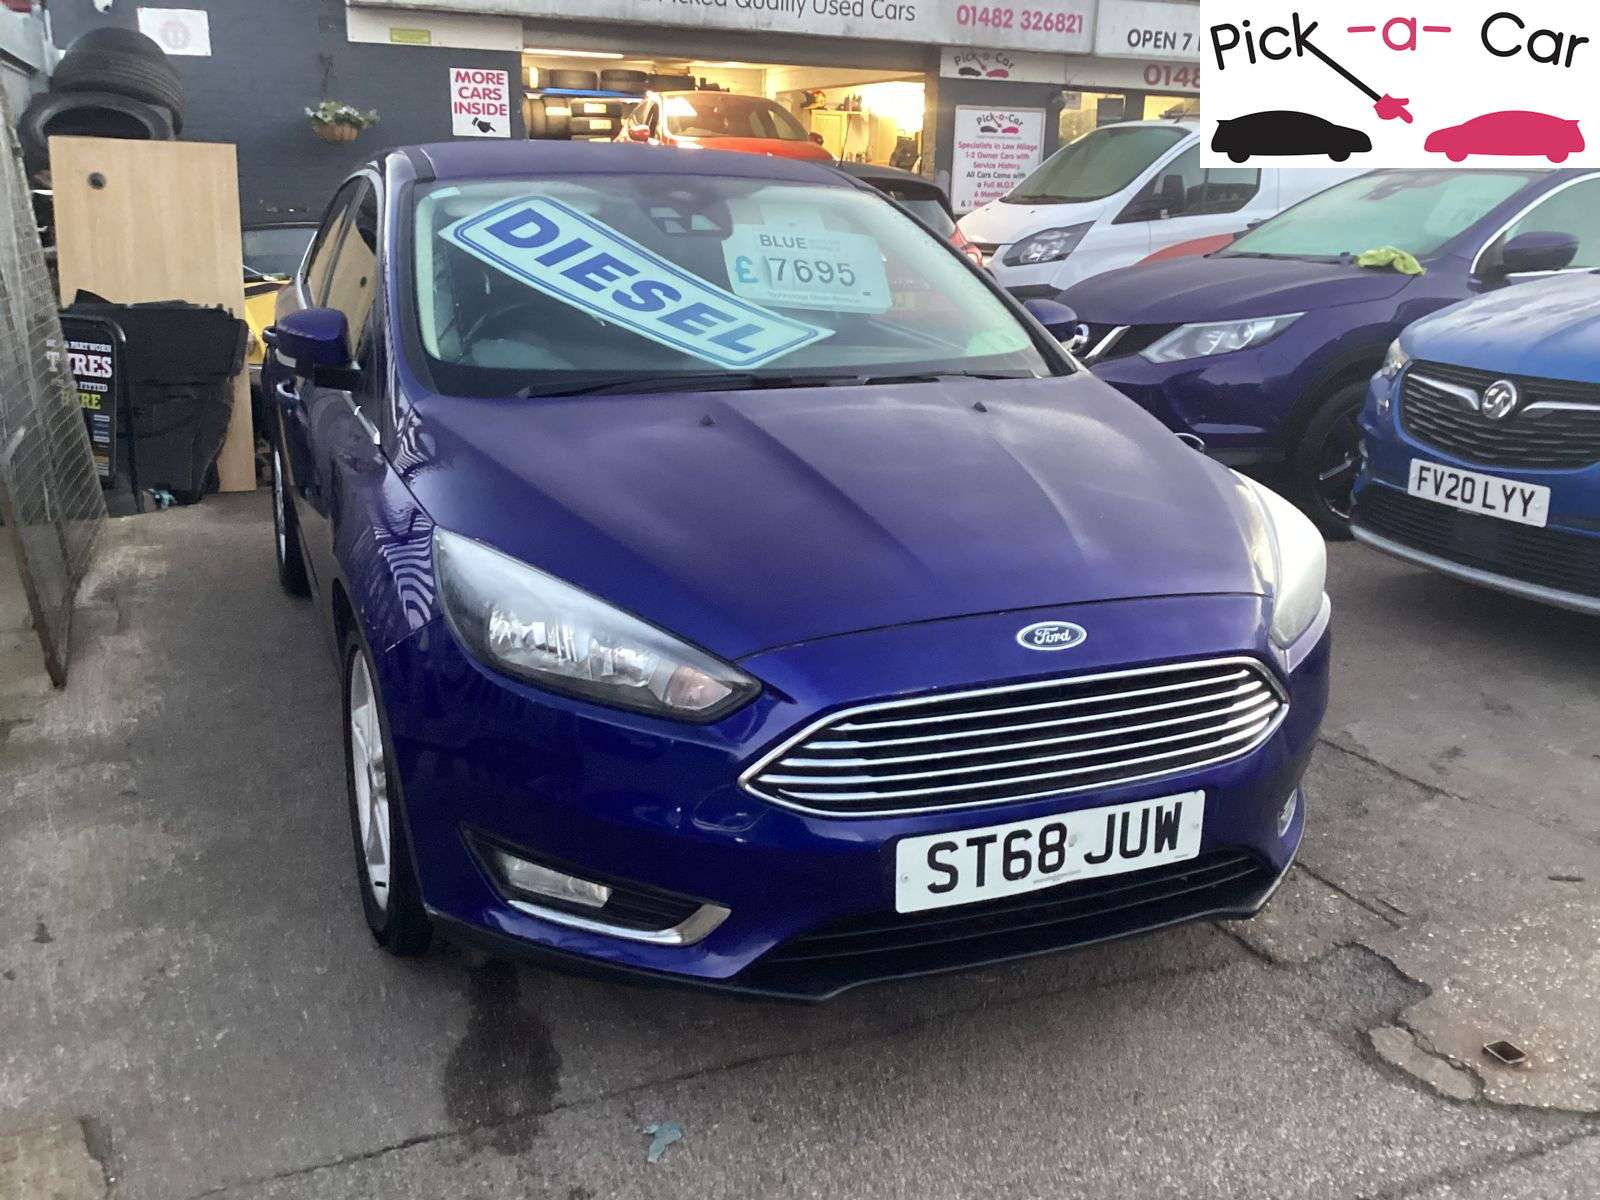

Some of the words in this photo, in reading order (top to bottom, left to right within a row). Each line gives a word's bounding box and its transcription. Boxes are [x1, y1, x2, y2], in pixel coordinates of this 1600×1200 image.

[812, 0, 864, 17] Used
[870, 2, 916, 21] Cars
[956, 5, 1014, 30] 01482
[1020, 10, 1083, 33] 326821
[1127, 28, 1177, 50] OPEN
[1182, 32, 1193, 51] 7
[455, 70, 505, 85] MORE
[458, 87, 502, 100] CARS
[454, 101, 508, 116] INSIDE
[759, 233, 809, 250] BLUE
[484, 207, 770, 354] DIESEL
[46, 351, 113, 378] TRES
[1416, 465, 1476, 504] FV20
[1481, 481, 1535, 517] LYY
[1034, 626, 1071, 645] Ford
[926, 821, 1068, 894] ST68
[1083, 801, 1183, 865] JUW
